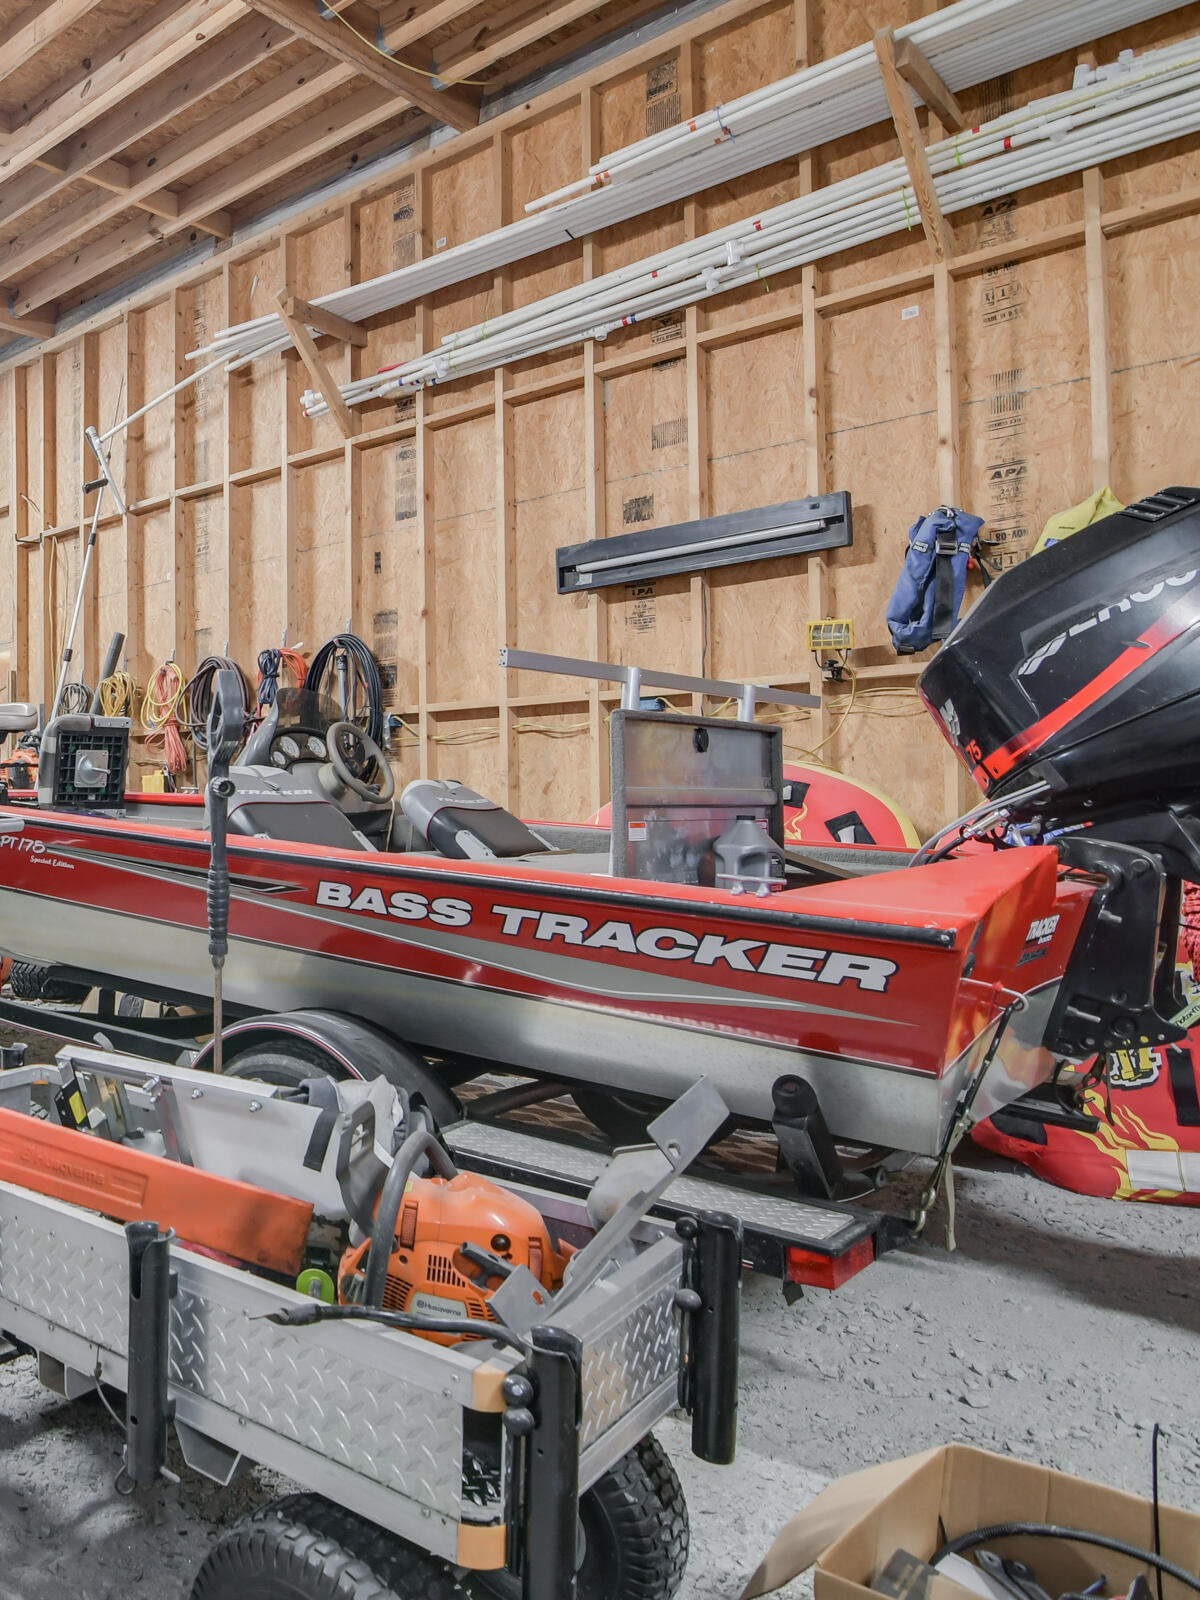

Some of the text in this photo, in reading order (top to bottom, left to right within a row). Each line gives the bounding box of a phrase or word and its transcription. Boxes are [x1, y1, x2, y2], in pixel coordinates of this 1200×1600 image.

[237, 788, 313, 797] TRACKER
[315, 880, 899, 993] BASS TRACKER
